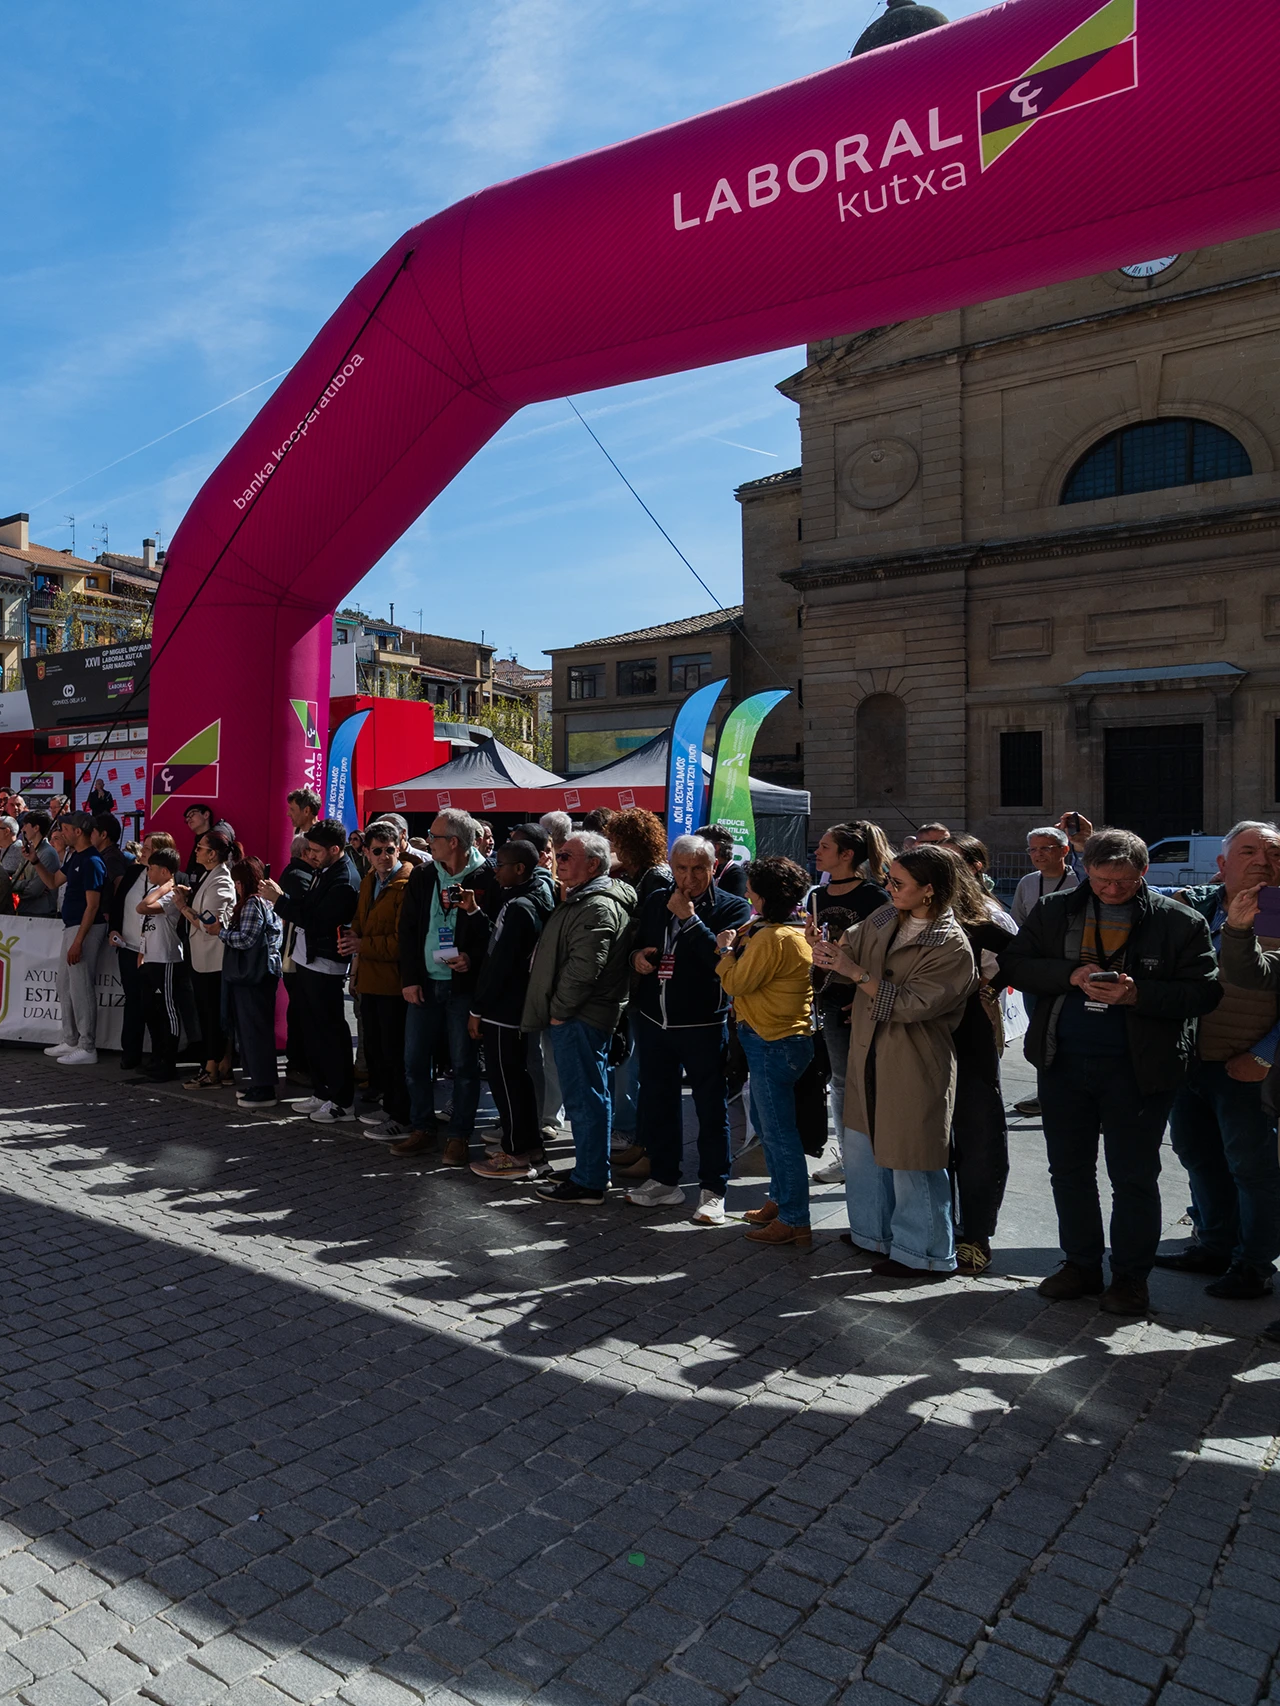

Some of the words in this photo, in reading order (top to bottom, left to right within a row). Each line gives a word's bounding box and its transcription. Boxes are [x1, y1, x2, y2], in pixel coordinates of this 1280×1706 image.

[673, 107, 963, 231] LABORAL
[837, 162, 967, 223] kutxa
[233, 462, 276, 510] banka
[272, 353, 365, 461] kooperatiboa
[674, 756, 686, 803] RECICLAMOS
[717, 818, 745, 827] REDUCE
[23, 1007, 62, 1021] UDAL
